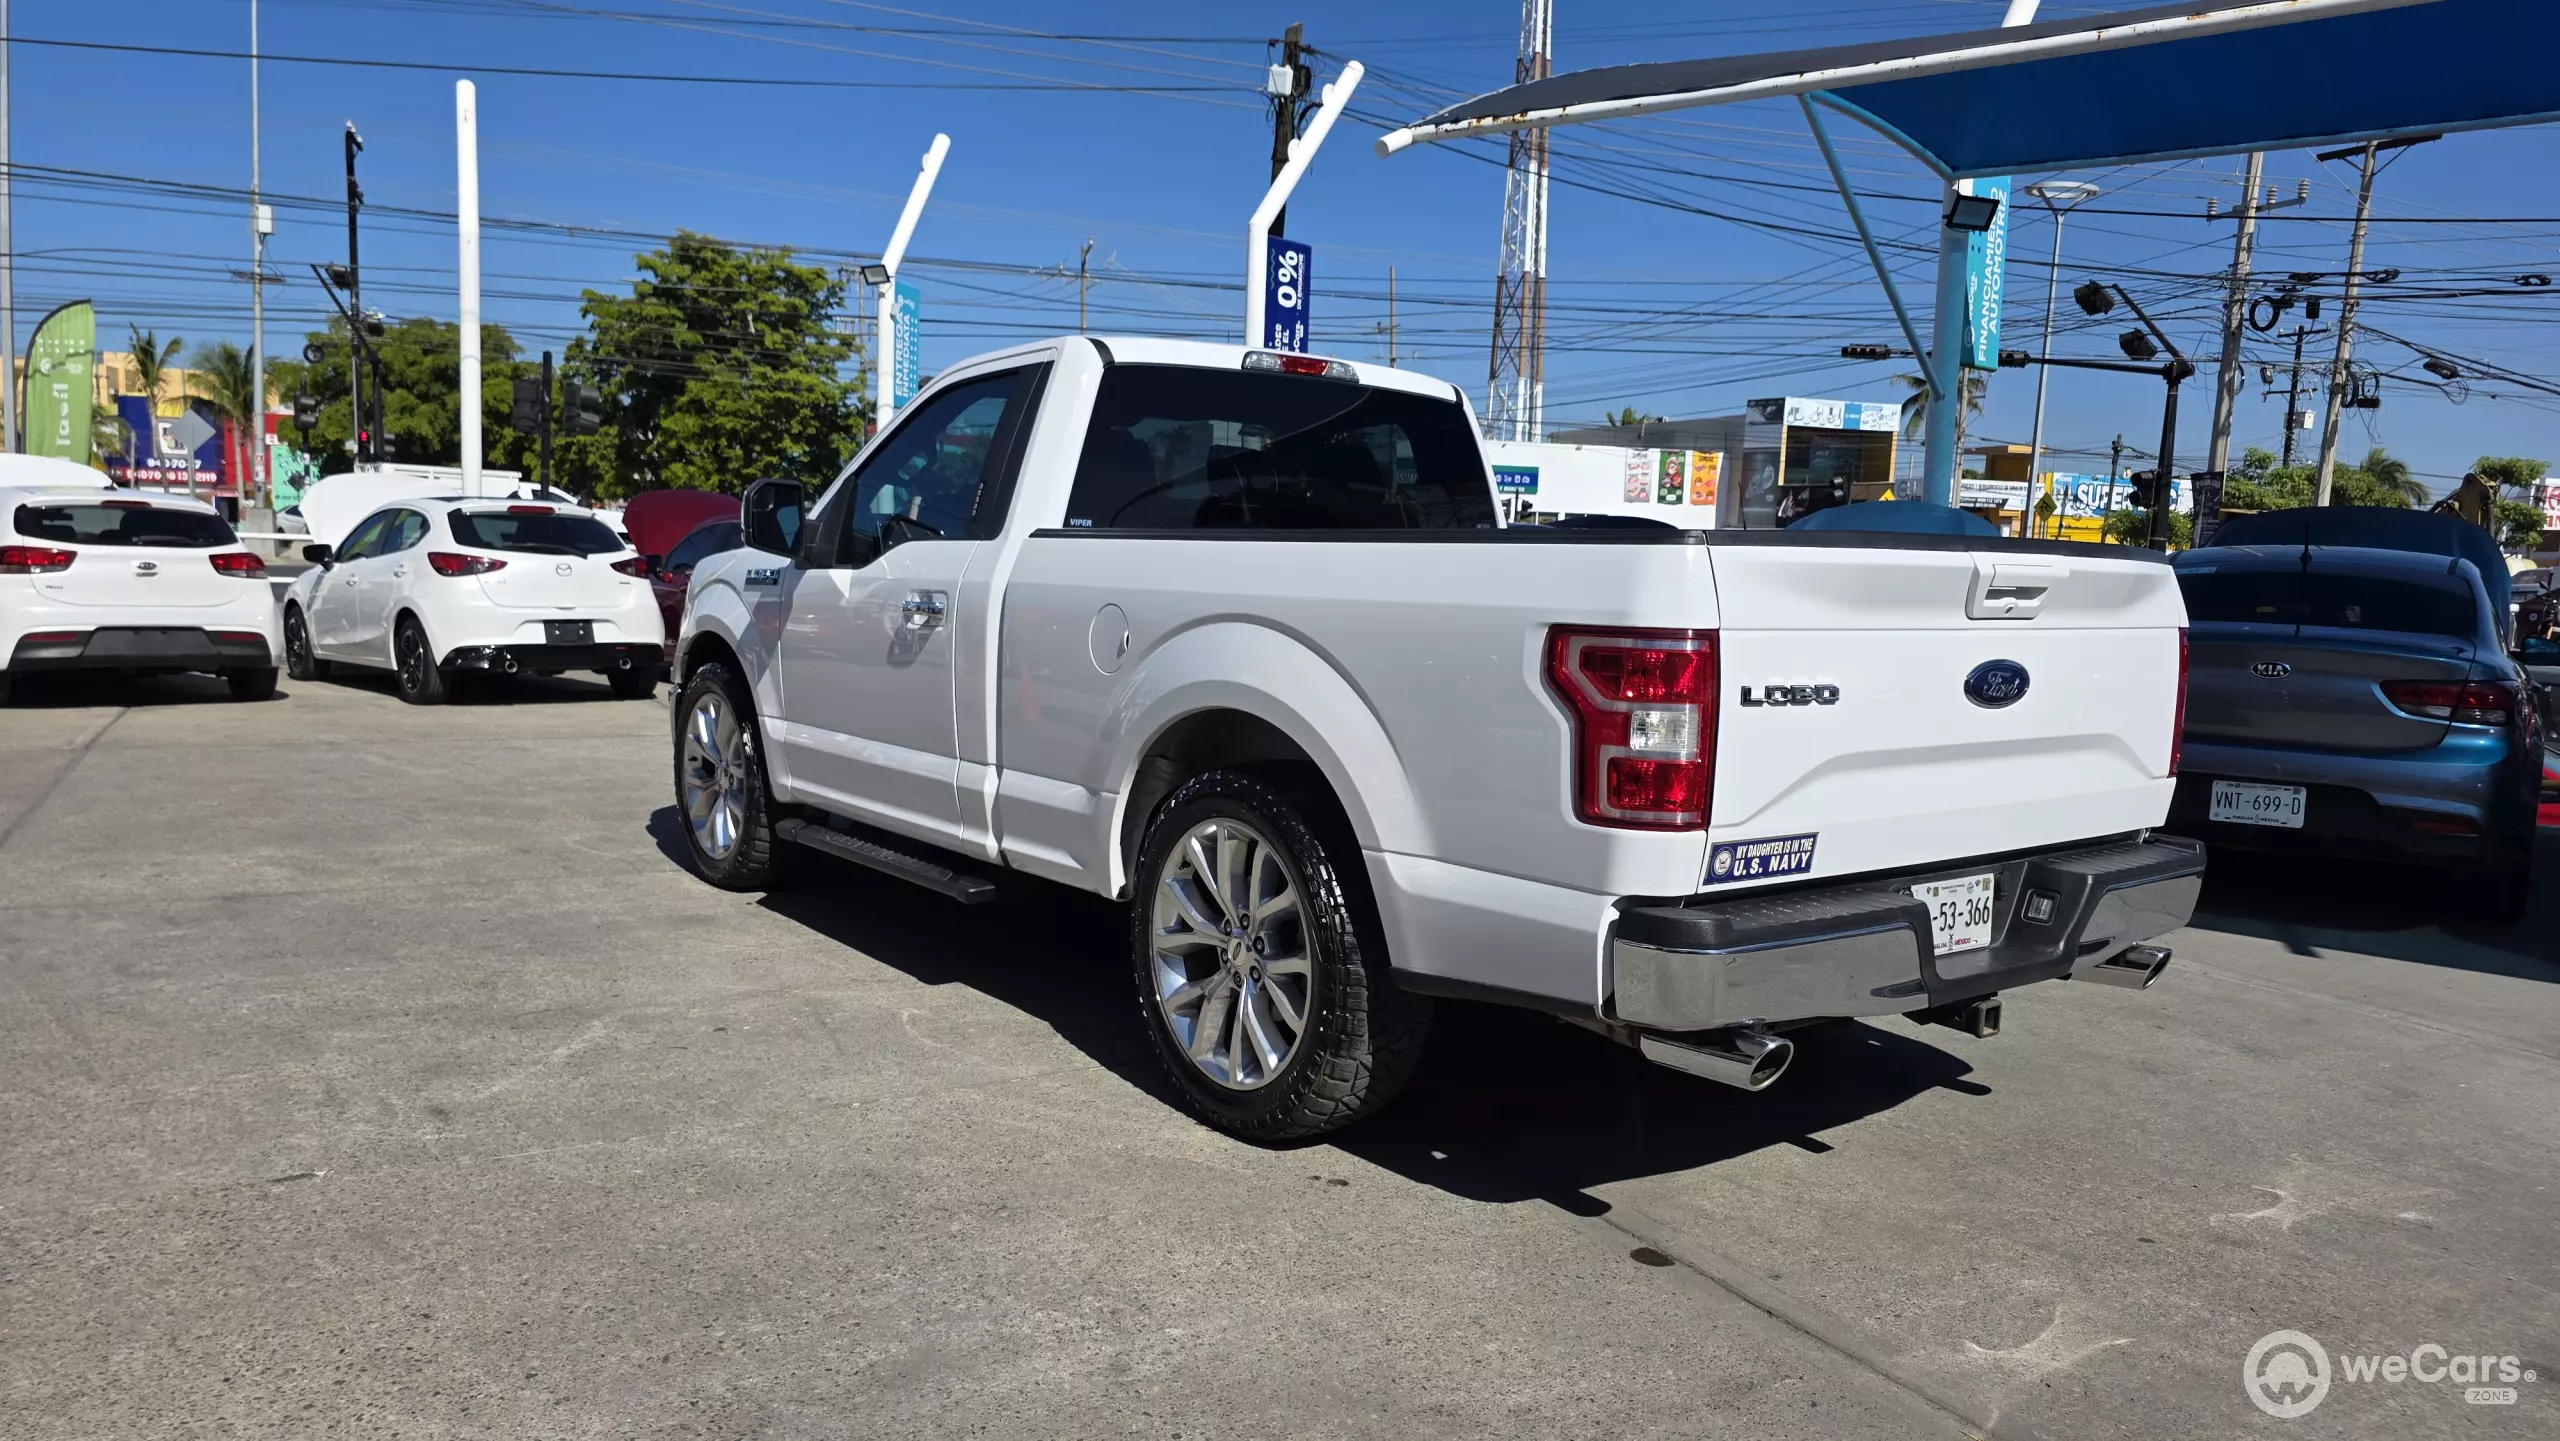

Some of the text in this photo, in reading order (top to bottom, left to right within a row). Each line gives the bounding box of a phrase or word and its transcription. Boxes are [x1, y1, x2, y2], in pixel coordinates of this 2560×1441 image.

[1978, 186, 1998, 362] FINANCIAMIENO
[1989, 190, 2007, 335] AUTOMOTRIZ
[1278, 250, 1299, 308] 0%
[1070, 518, 1092, 527] VIPER
[1740, 684, 1840, 706] LOBO
[2216, 790, 2301, 815] VNT-699-D
[1736, 838, 1814, 859] MY DAUGHTER IS IN THE
[1768, 852, 1811, 872] NAVY
